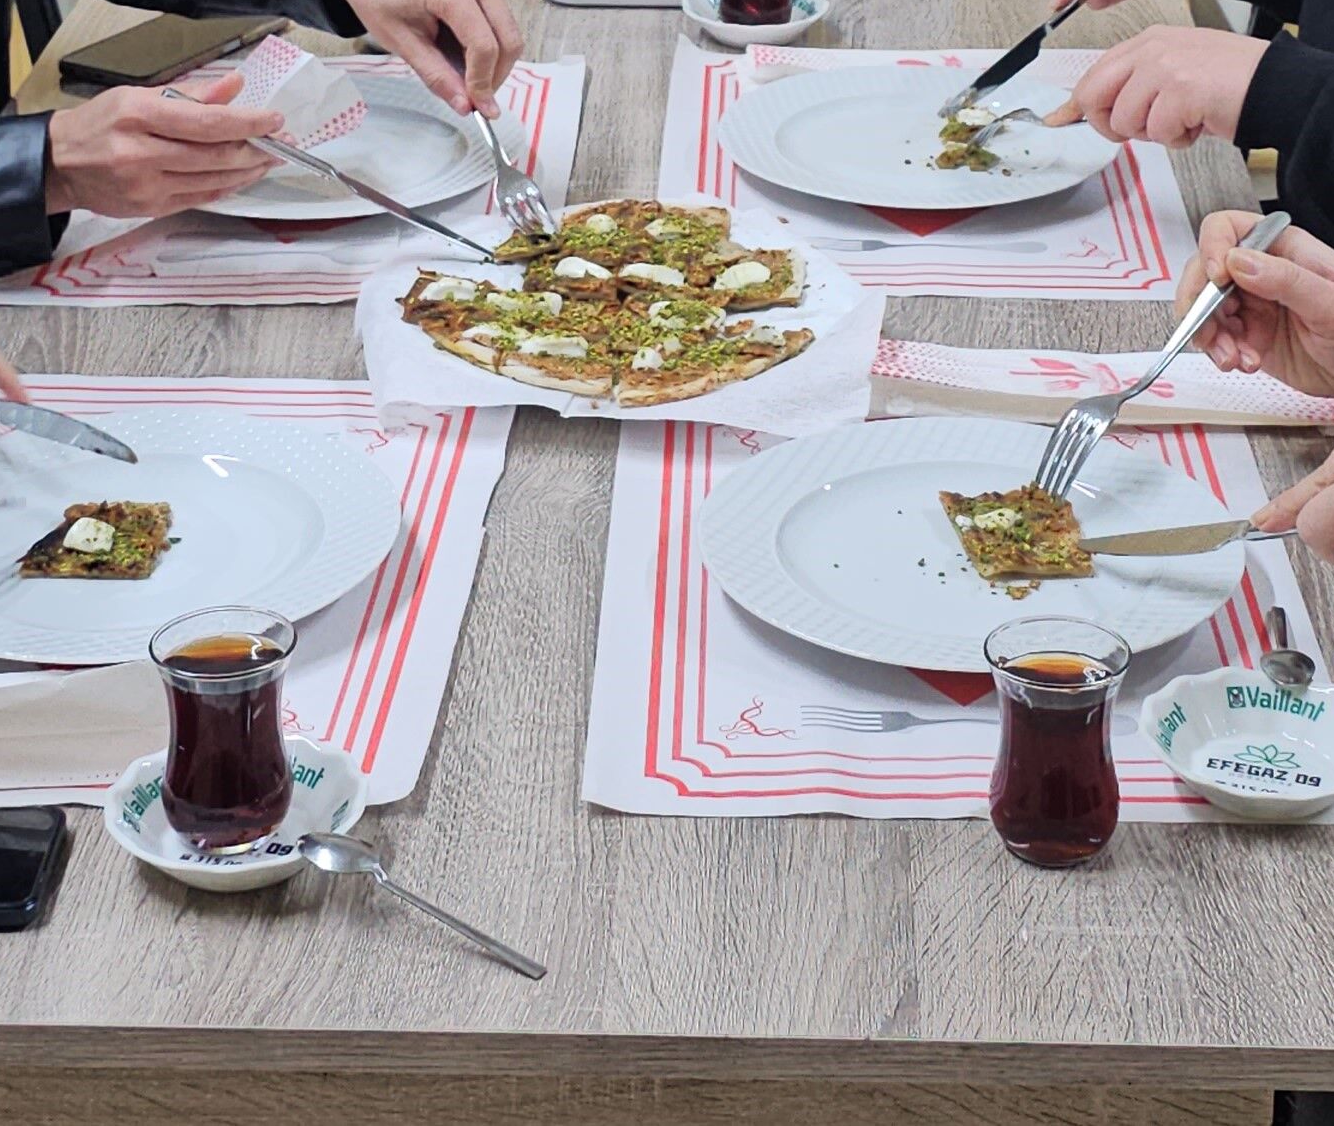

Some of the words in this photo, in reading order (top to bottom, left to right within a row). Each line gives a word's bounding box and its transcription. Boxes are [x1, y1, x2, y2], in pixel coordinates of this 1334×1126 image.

[1246, 685, 1326, 722] Vaillant
[1206, 757, 1289, 781] EFEGAZ
[1294, 772, 1322, 788] 09
[266, 841, 295, 856] 09
